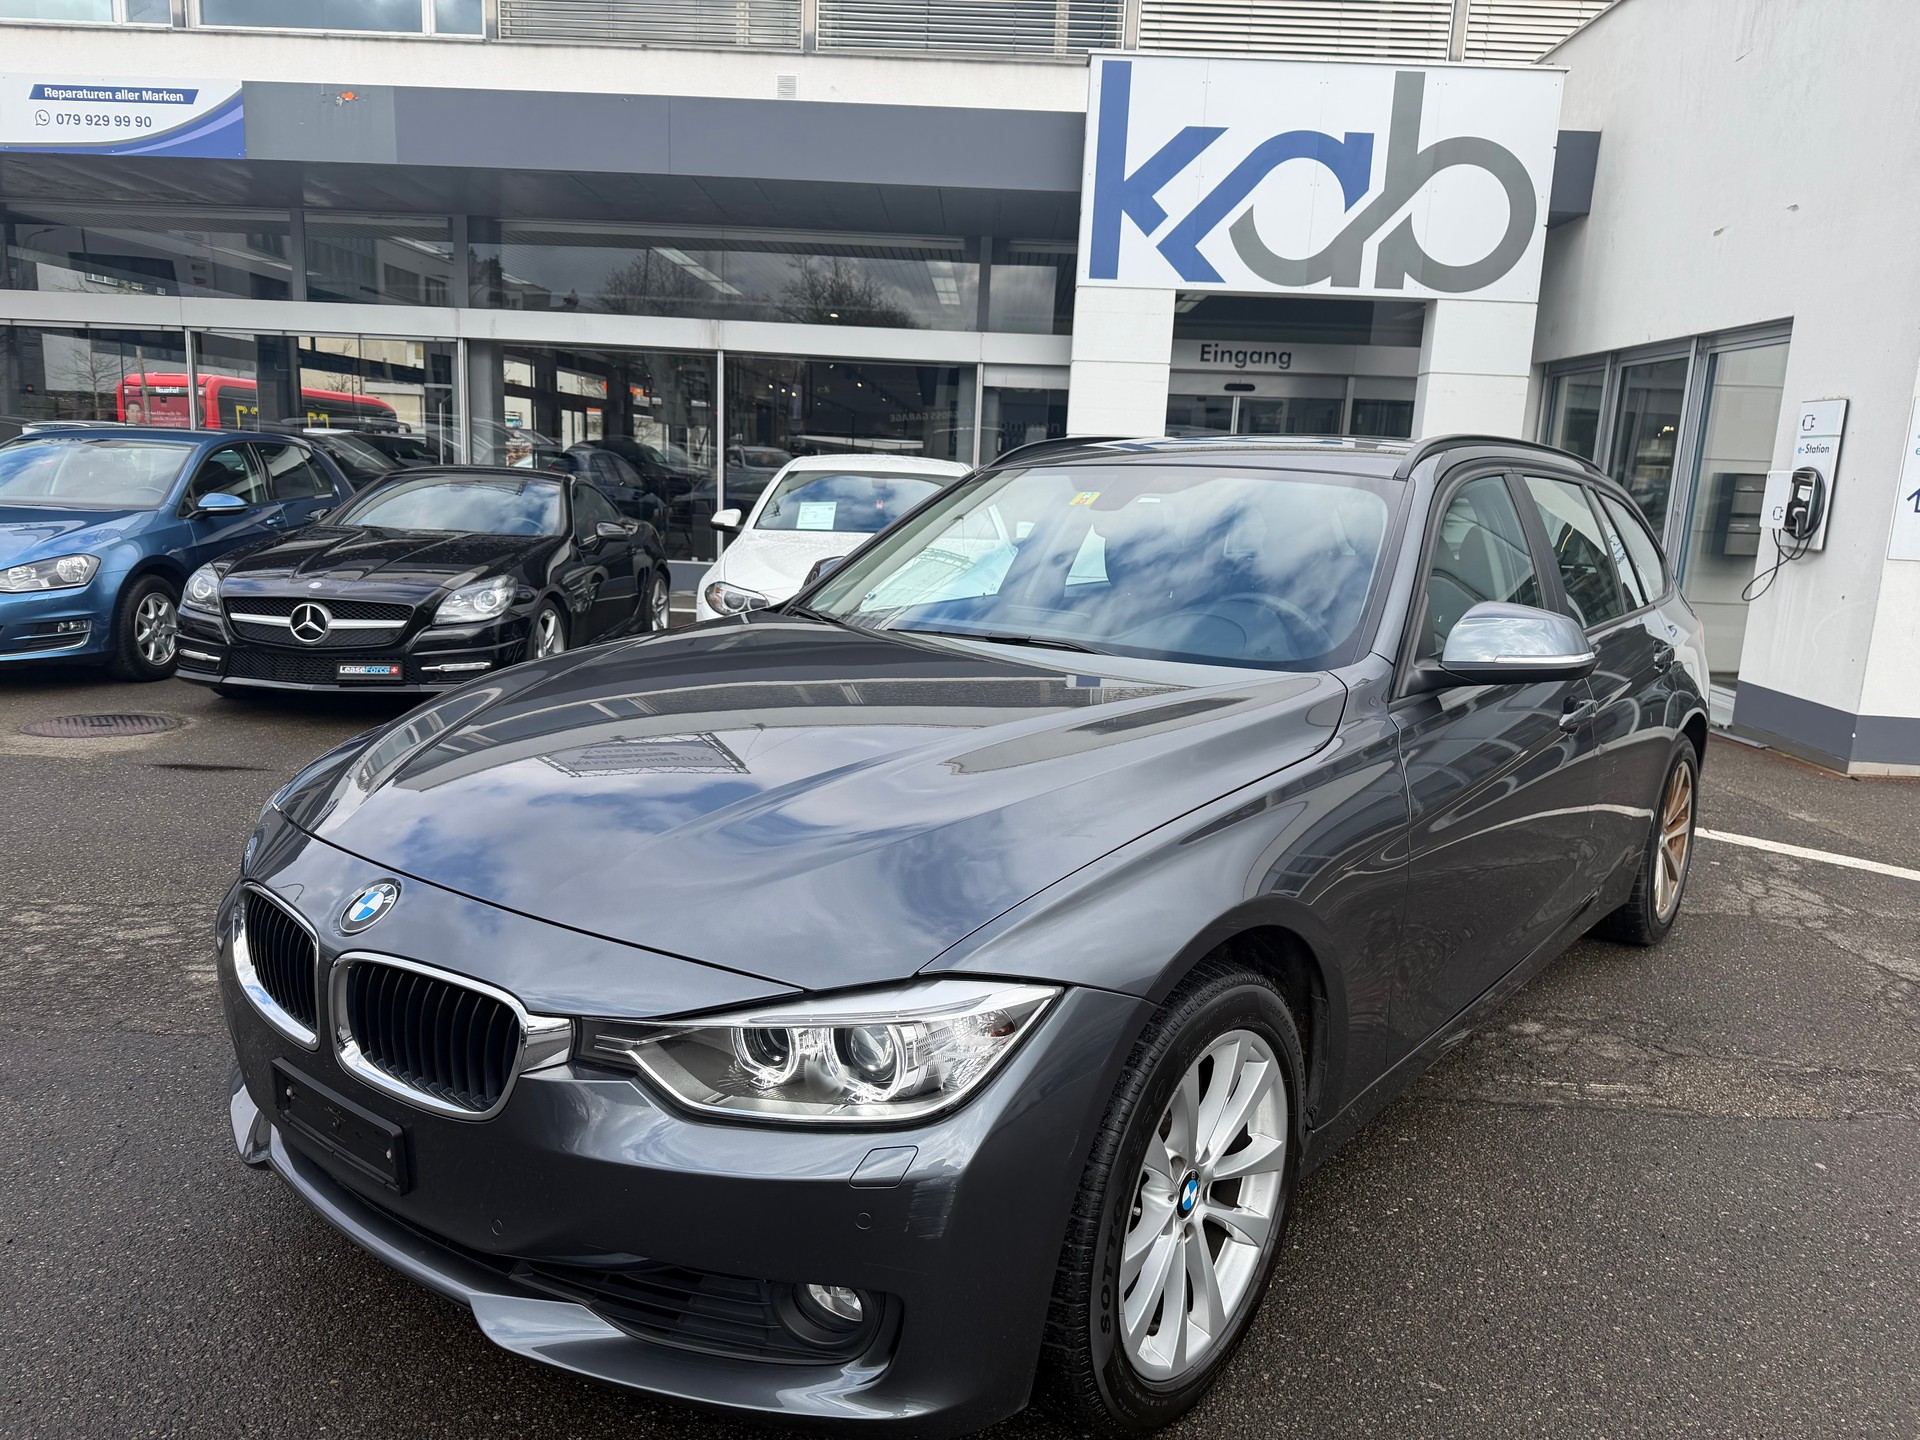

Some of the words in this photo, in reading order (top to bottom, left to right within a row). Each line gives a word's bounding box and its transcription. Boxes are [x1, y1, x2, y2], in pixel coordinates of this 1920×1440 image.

[44, 87, 112, 100] Reparaturen
[115, 89, 140, 100] aller
[142, 90, 184, 102] Marken
[56, 113, 81, 125] 079
[85, 114, 110, 126] 929
[114, 115, 131, 127] 99
[135, 116, 152, 128] 90
[1089, 60, 1537, 293] kab
[1200, 343, 1292, 369] Eingang
[1797, 443, 1830, 454] e-Station
[340, 665, 390, 674] LeaseForce
